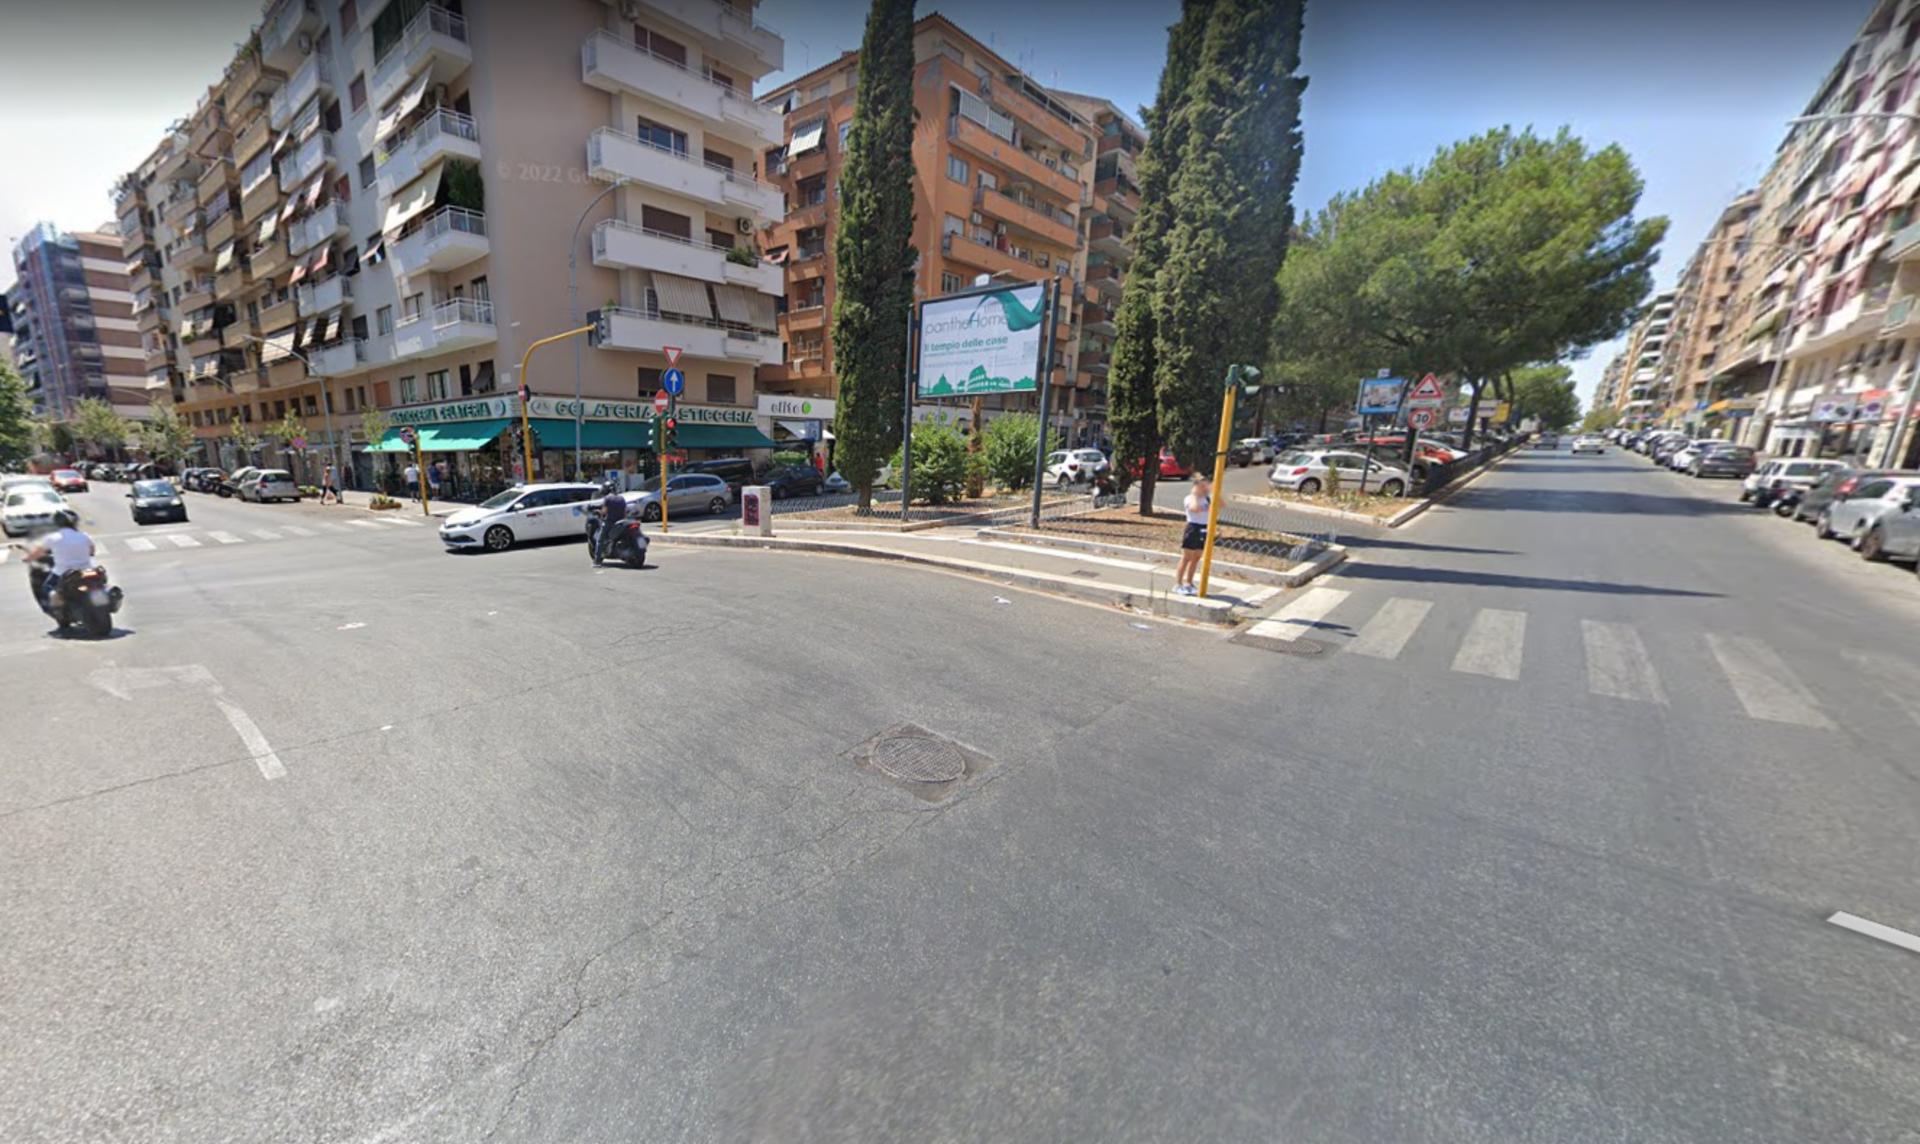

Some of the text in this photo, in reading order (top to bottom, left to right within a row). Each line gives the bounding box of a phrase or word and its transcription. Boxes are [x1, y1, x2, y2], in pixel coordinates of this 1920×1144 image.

[930, 341, 961, 352] tempio
[962, 337, 984, 348] delle
[985, 335, 1009, 345] case
